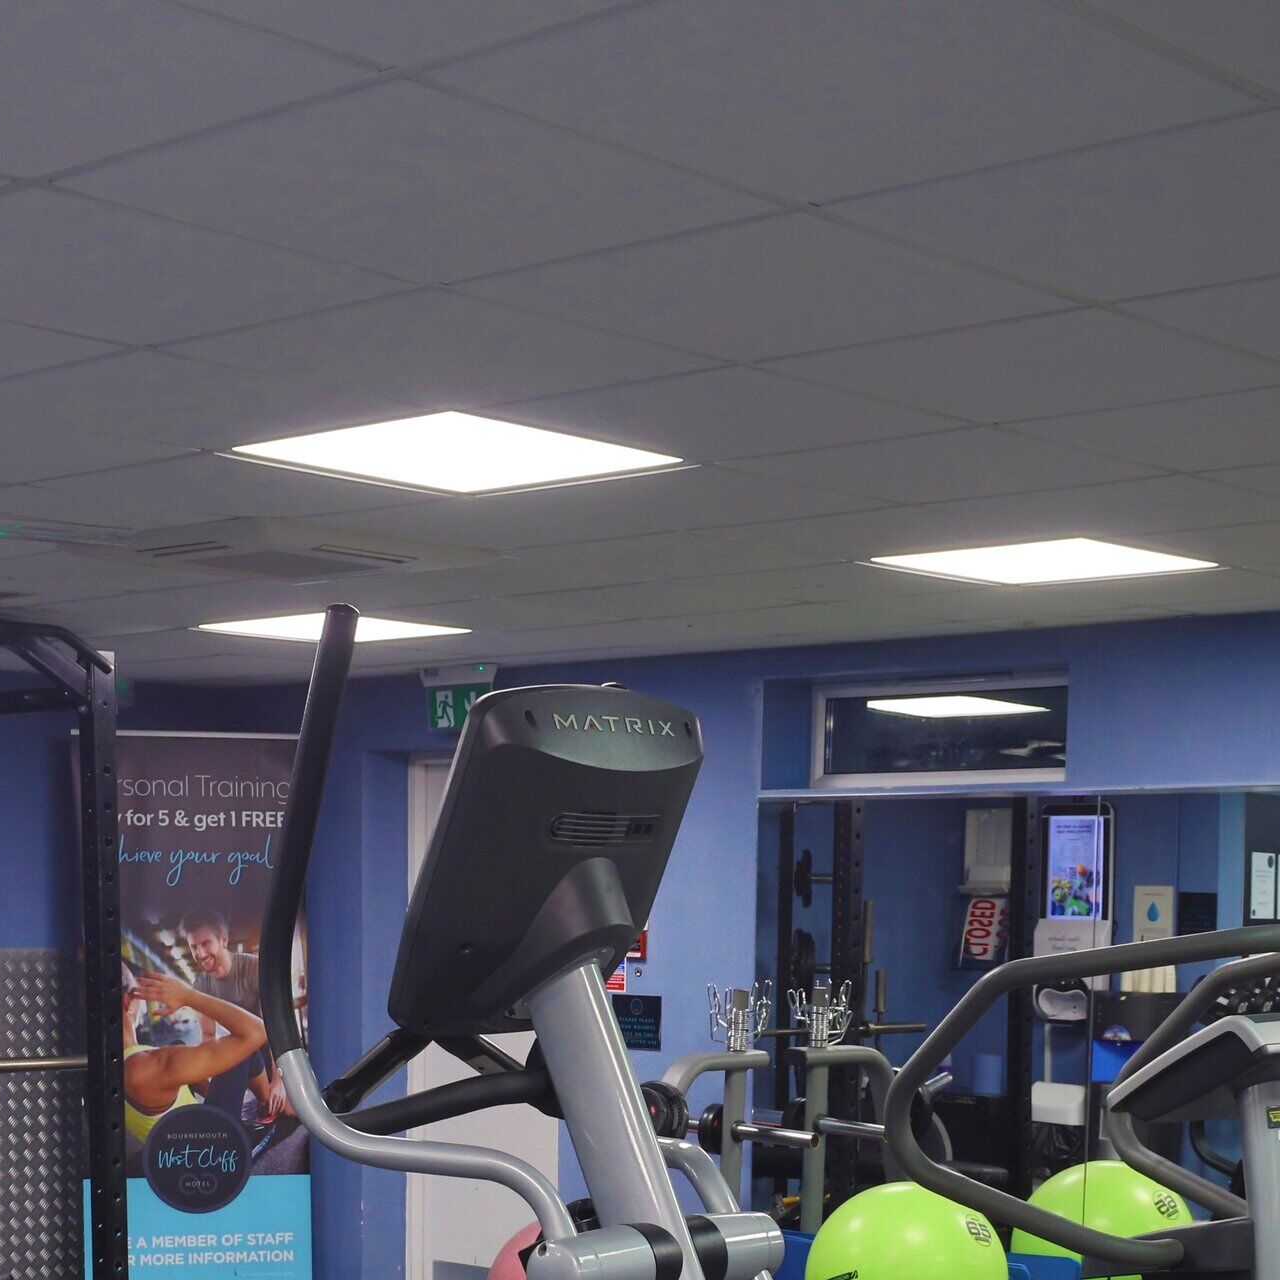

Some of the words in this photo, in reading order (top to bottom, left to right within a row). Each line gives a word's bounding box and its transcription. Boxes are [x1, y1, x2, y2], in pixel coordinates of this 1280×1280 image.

[552, 712, 676, 738] MATRIX
[195, 775, 290, 804] Training
[126, 809, 155, 826] for
[158, 810, 169, 826] 5
[175, 809, 190, 827] &
[194, 812, 225, 831] get
[231, 811, 236, 827] 1
[166, 848, 220, 886] your
[228, 834, 274, 885] goal
[167, 1132, 228, 1140] BOURNEMOUTH
[198, 1145, 240, 1172] Cliff
[185, 1180, 211, 1188] HOTEL
[136, 1236, 148, 1249] A
[152, 1234, 217, 1248] MEMBER
[221, 1234, 243, 1246] OF
[247, 1232, 294, 1245] STAFF
[140, 1252, 184, 1266] MORE
[188, 1250, 294, 1265] INFORMATION
